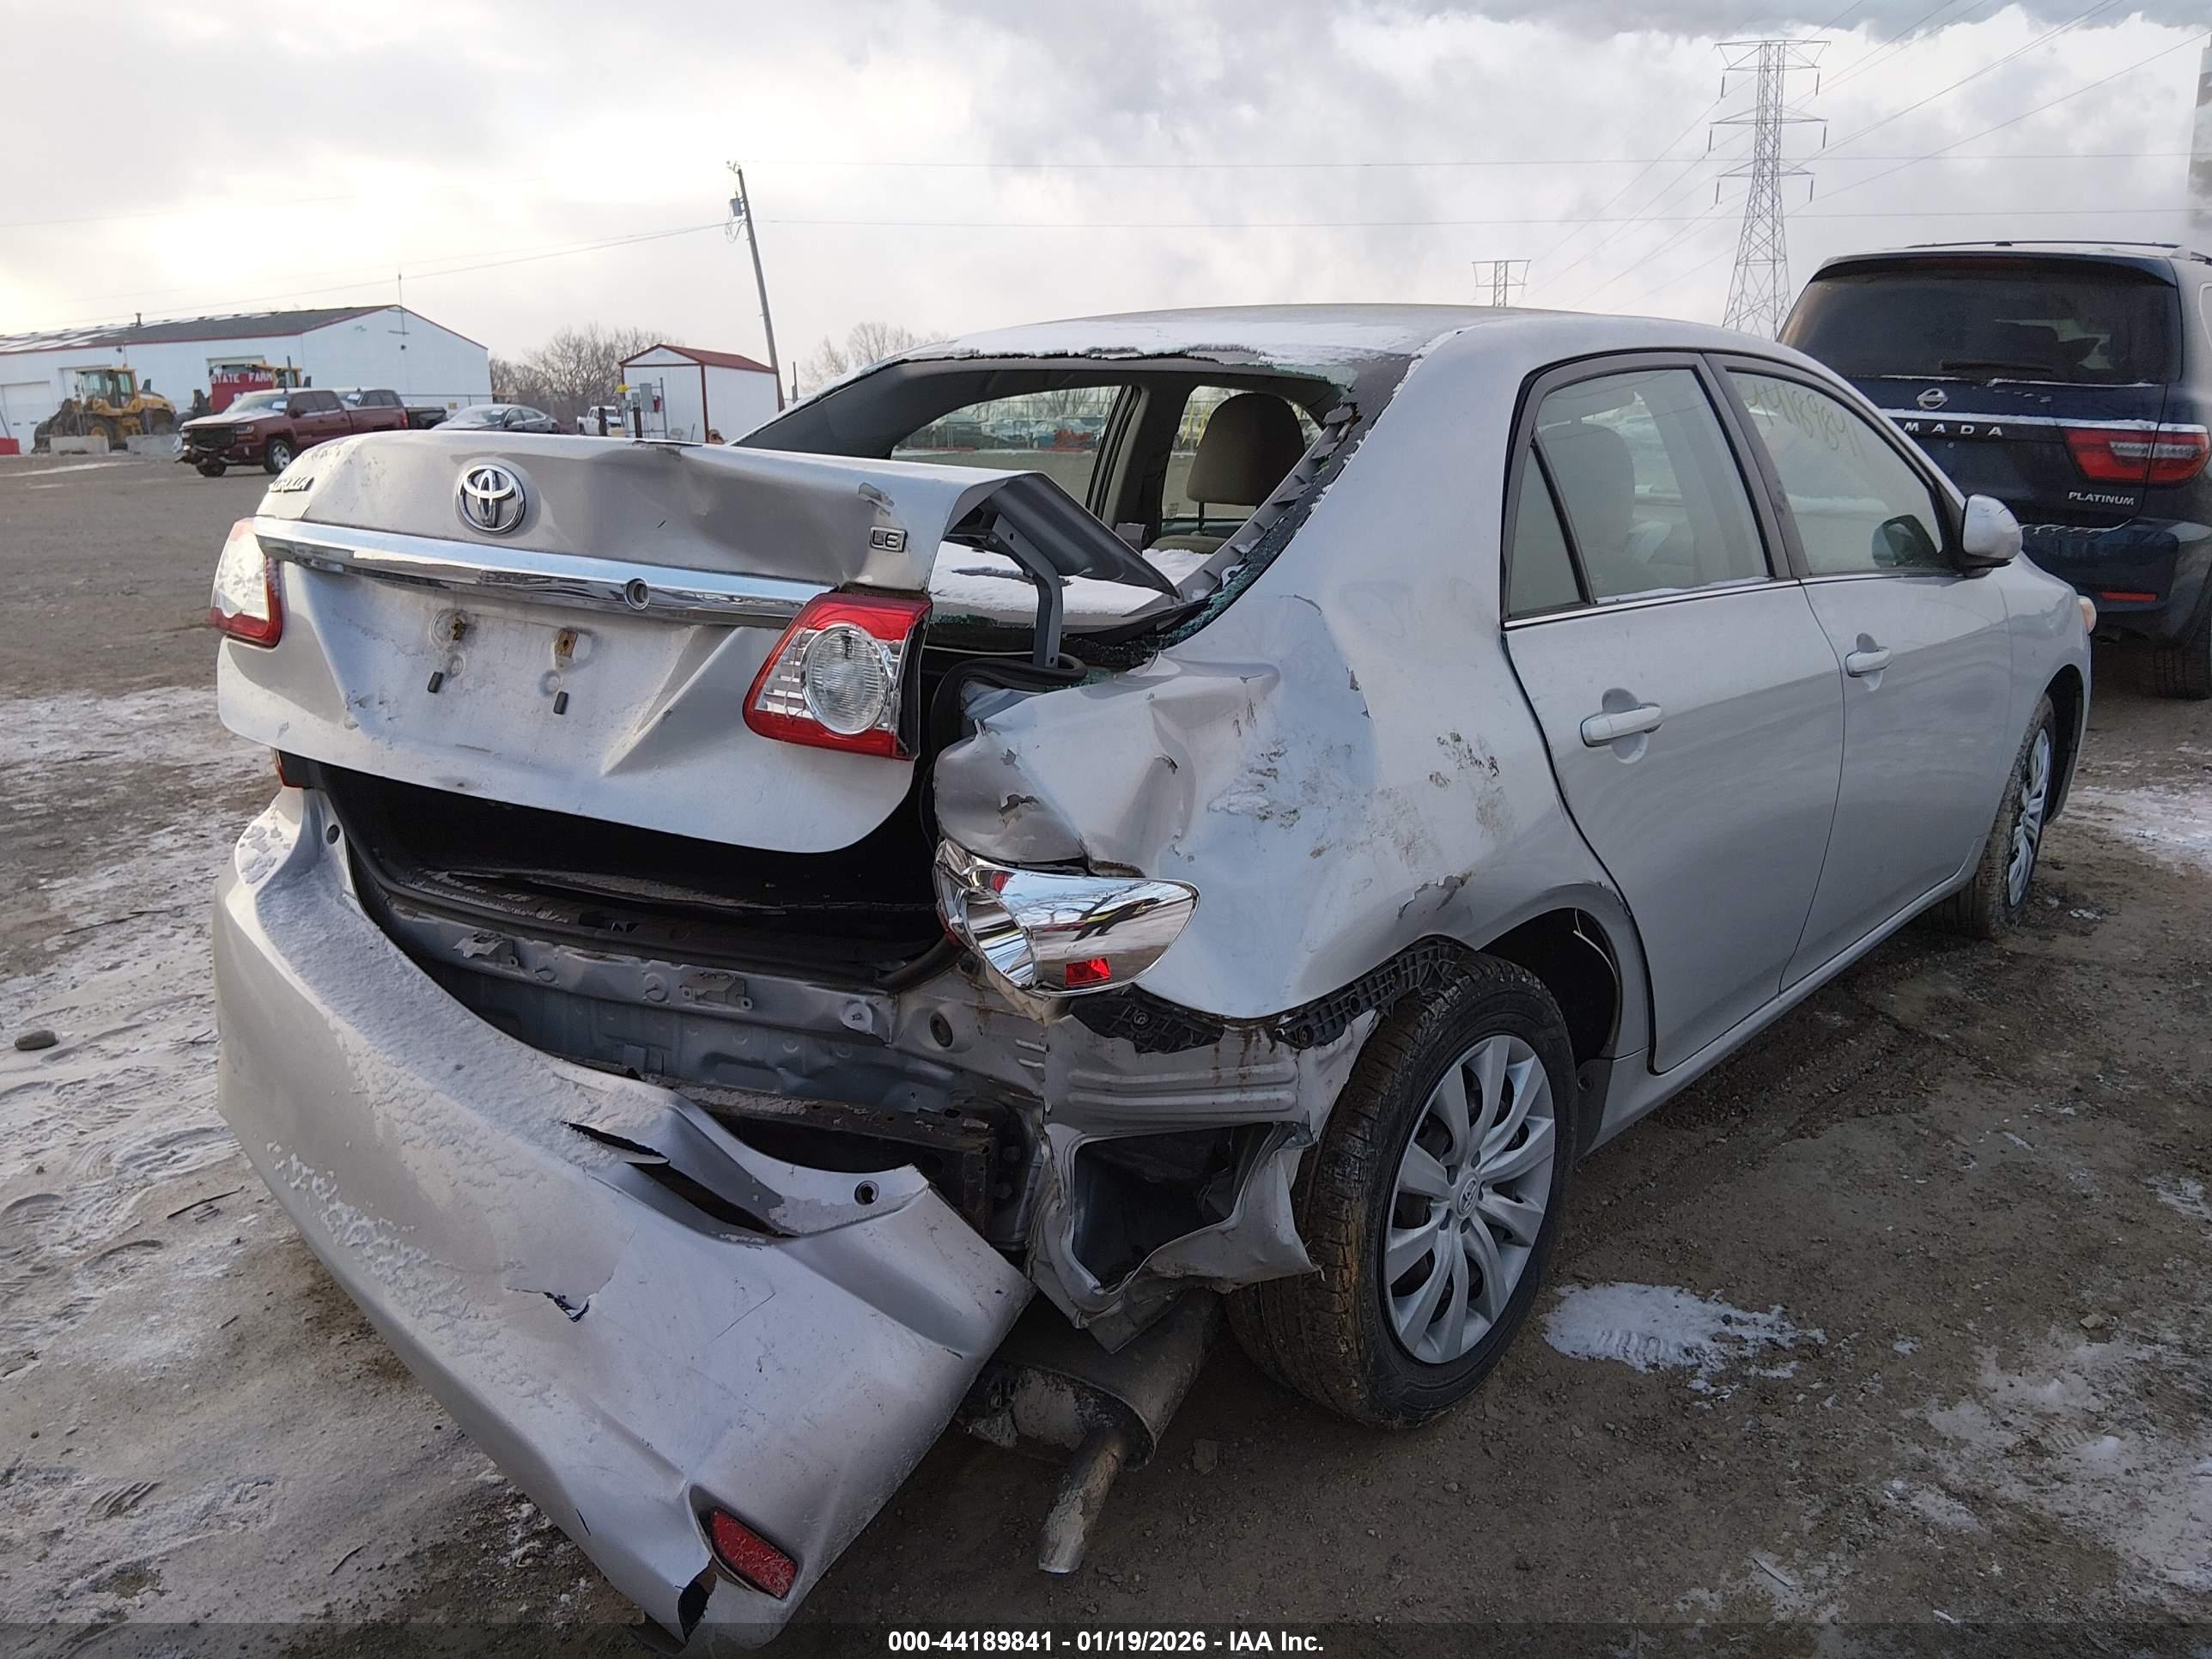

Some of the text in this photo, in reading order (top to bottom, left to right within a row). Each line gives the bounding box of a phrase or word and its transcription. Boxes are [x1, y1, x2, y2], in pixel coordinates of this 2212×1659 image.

[210, 373, 240, 385] STATE
[1904, 422, 2003, 437] MADA
[2068, 491, 2135, 506] PLATINUM
[872, 527, 902, 550] LE
